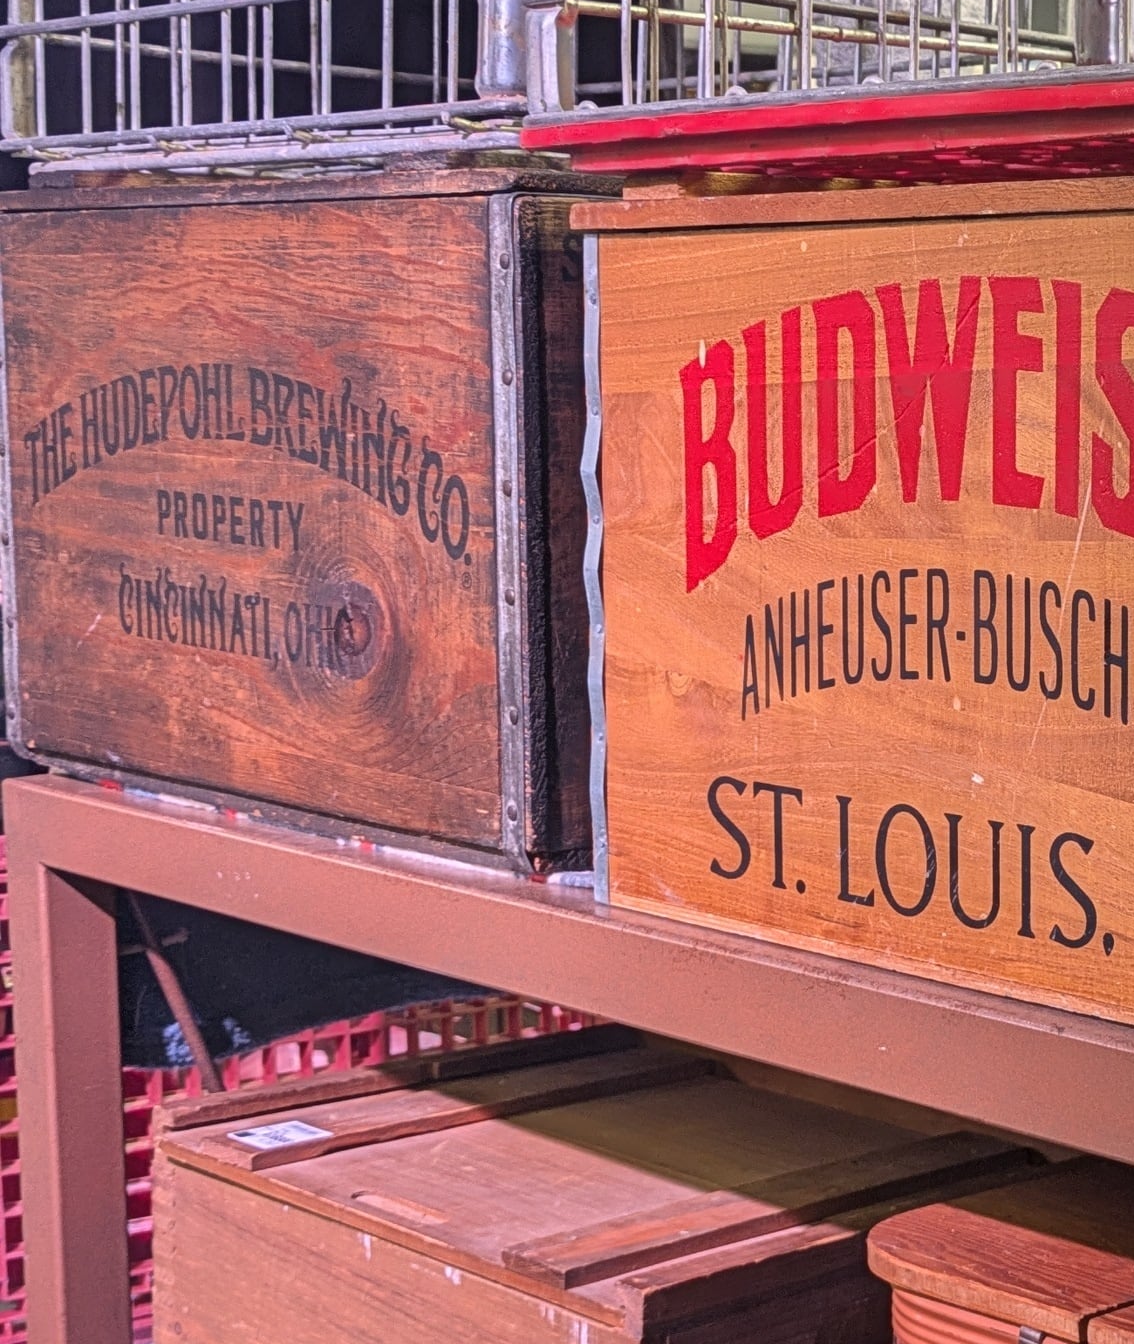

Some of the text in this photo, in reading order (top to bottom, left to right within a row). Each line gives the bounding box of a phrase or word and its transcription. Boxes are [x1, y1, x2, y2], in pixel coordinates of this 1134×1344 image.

[24, 362, 472, 567] THE HUDEPOHL BREWING CO.
[157, 488, 305, 552] PROPERTY
[119, 562, 372, 672] CINCINNATI, OHIO
[741, 567, 1130, 726] ANHEUSER-BUSCH
[707, 775, 807, 894] ST.
